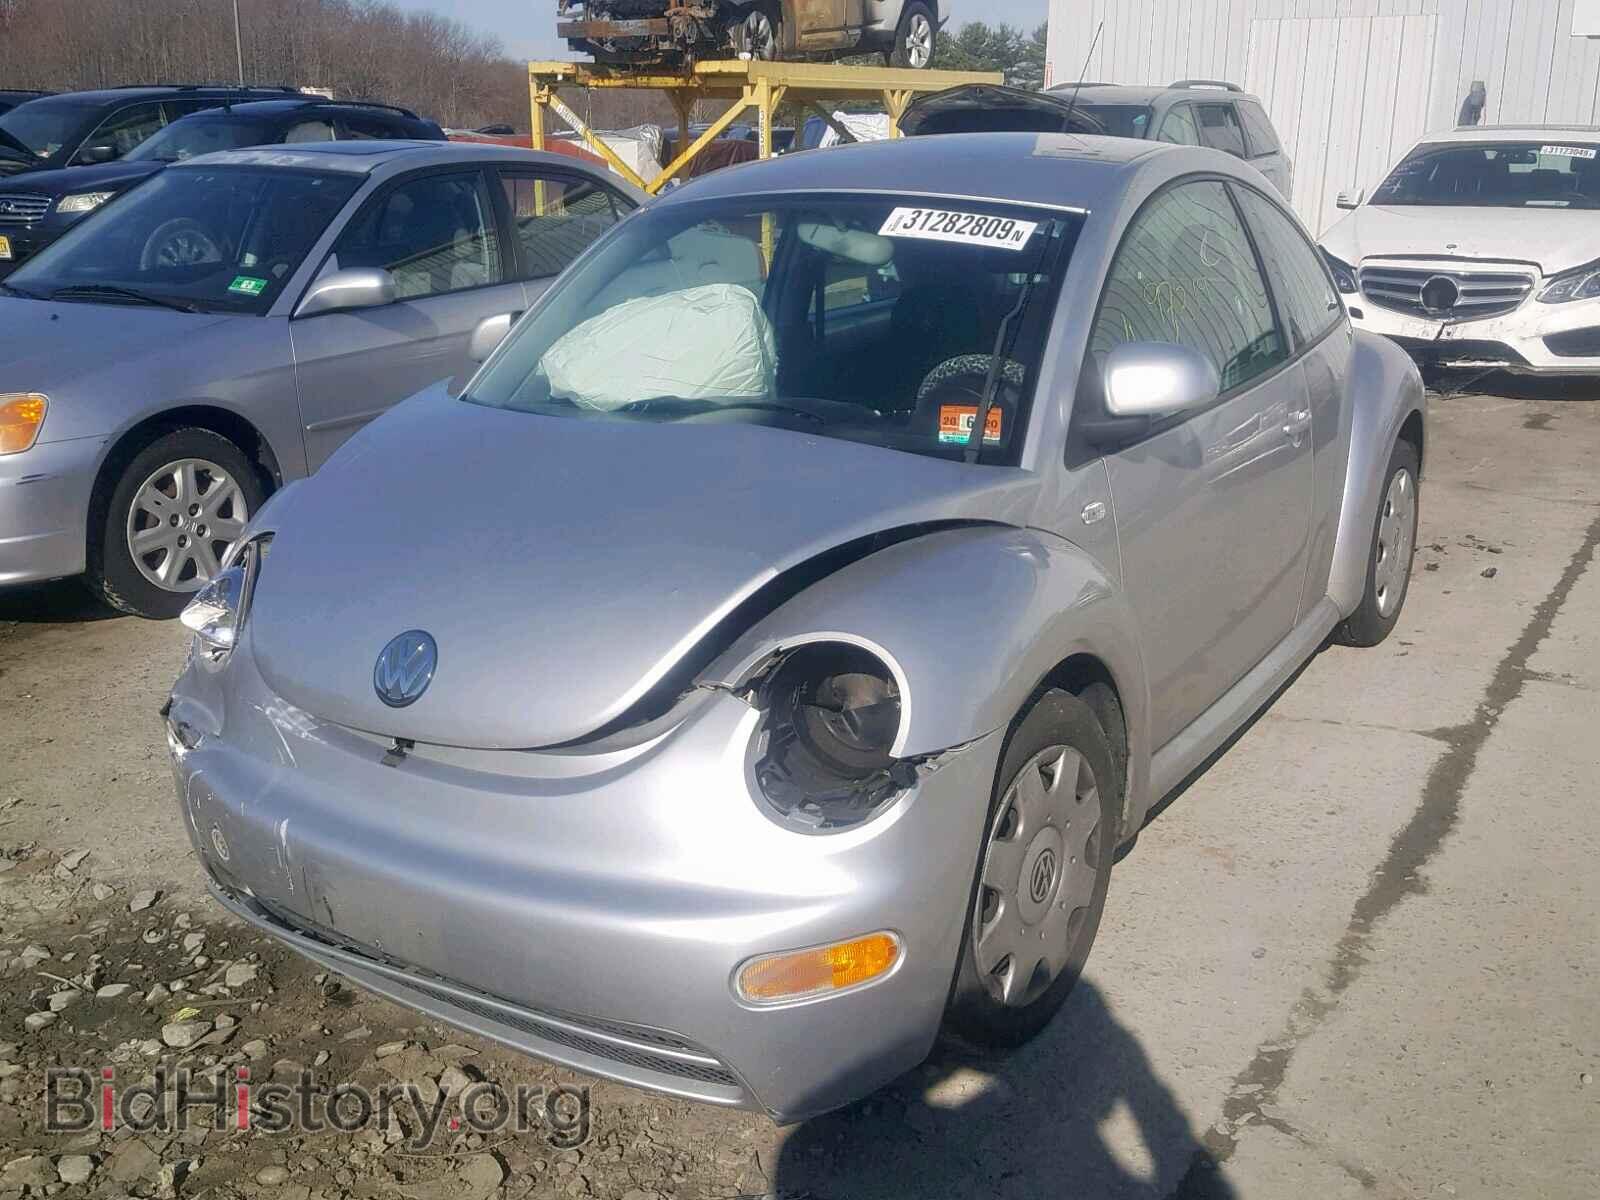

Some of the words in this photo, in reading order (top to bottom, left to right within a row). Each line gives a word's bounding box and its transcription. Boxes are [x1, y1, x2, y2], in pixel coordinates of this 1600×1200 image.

[903, 210, 1016, 240] 31282809
[1012, 229, 1025, 242] N
[943, 416, 957, 426] 20
[966, 415, 976, 429] 6
